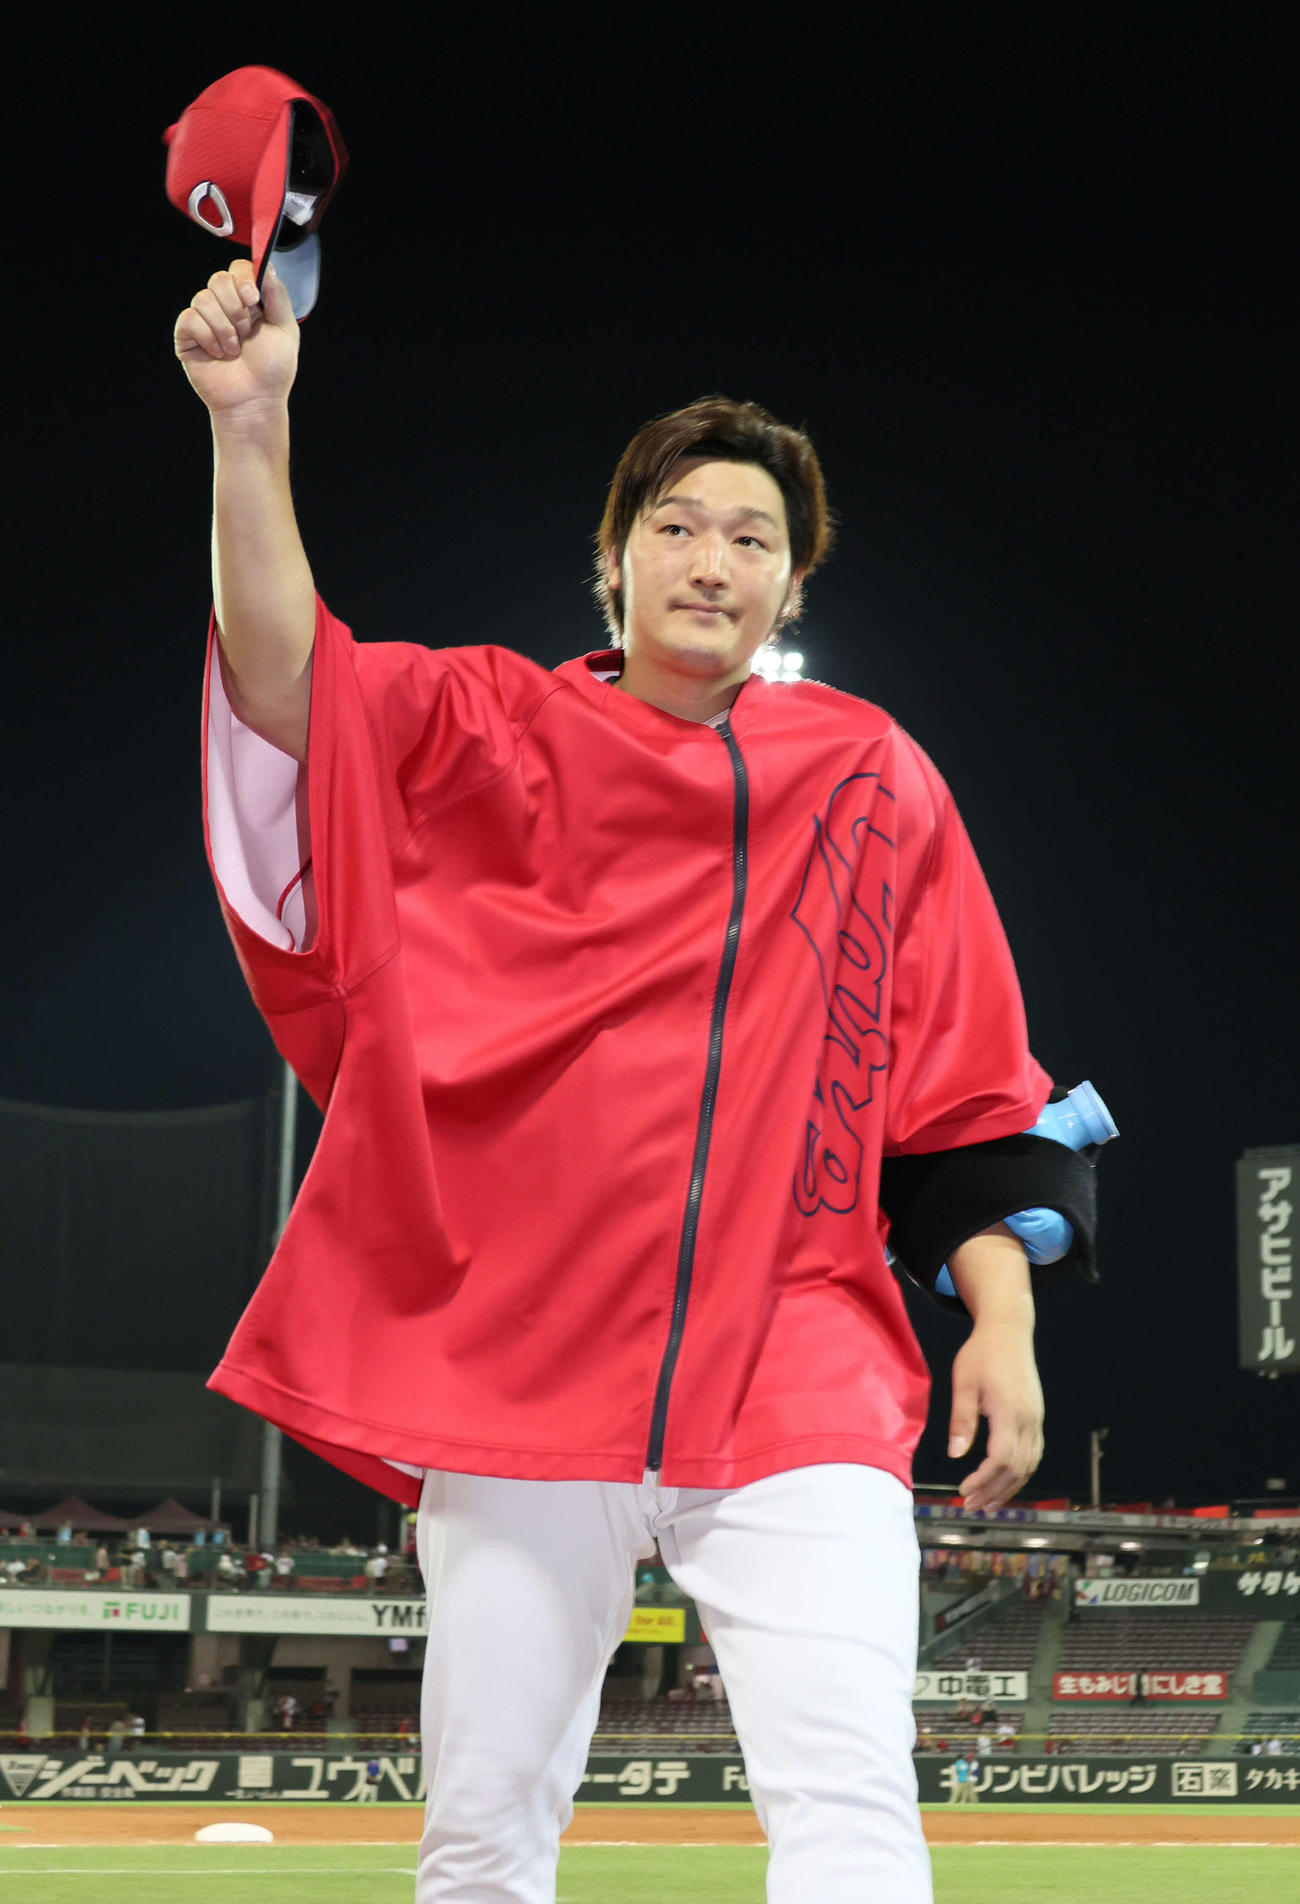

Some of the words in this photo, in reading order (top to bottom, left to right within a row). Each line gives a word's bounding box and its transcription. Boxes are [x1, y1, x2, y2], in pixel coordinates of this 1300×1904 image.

[1257, 1167, 1295, 1361] アサヒビール
[1103, 1582, 1195, 1601] LOGICOM
[126, 1602, 179, 1620] FUJI
[938, 1675, 1017, 1697] 中電工
[28, 1755, 220, 1798] ジーベック
